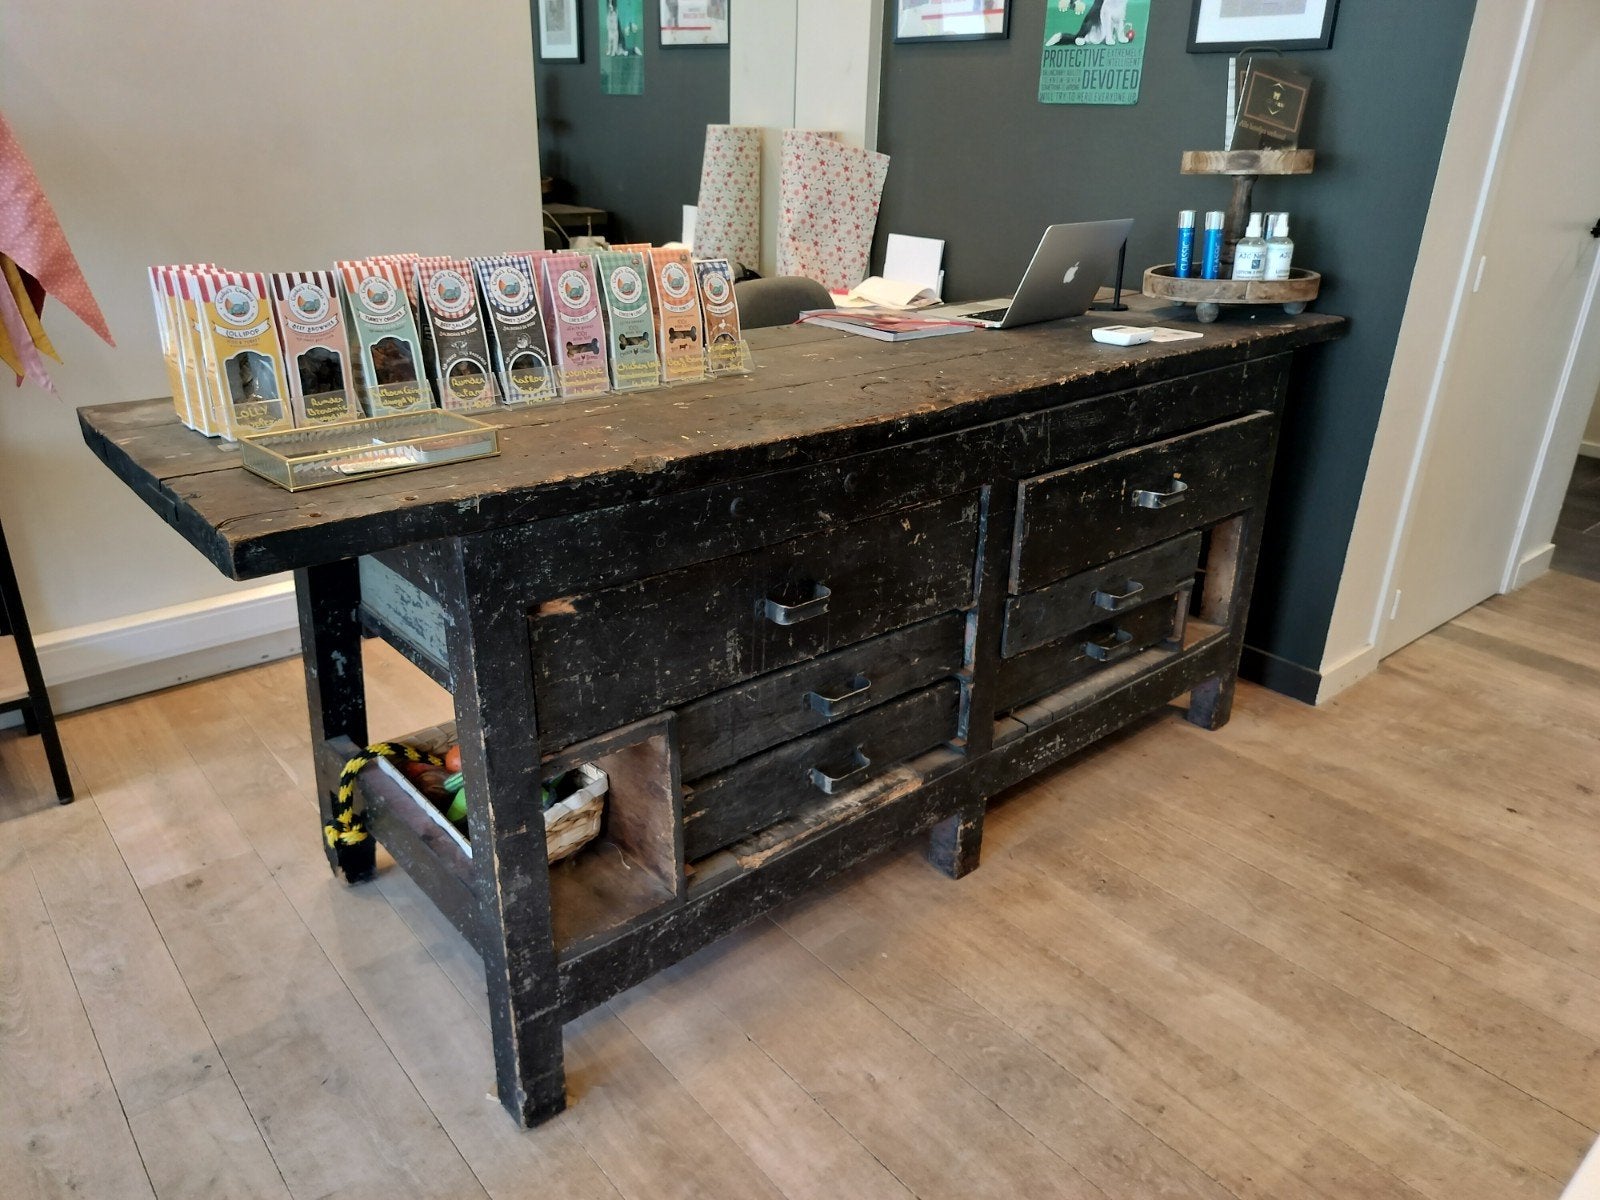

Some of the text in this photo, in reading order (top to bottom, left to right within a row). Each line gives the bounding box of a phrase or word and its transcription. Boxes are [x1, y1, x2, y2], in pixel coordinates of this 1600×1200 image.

[1043, 48, 1106, 68] PROTECTIVE
[1082, 69, 1140, 90] DEVOTED
[1180, 240, 1190, 272] CLASSIC
[226, 328, 260, 338] LOLLIPOP
